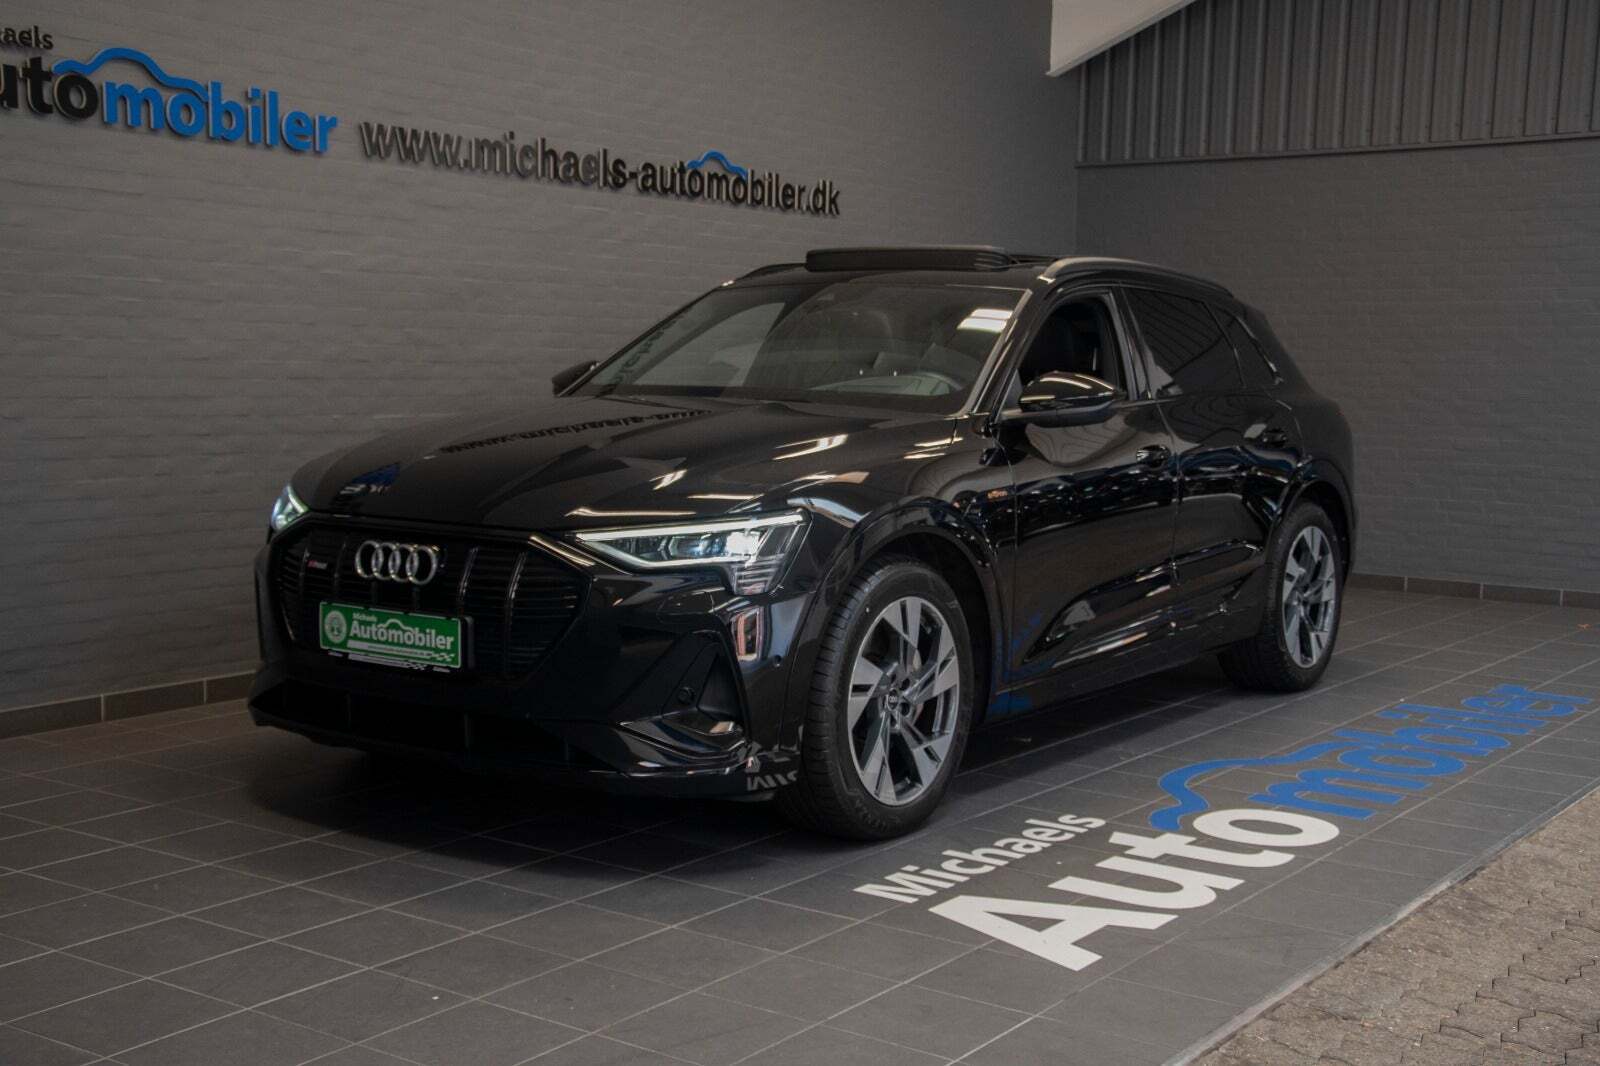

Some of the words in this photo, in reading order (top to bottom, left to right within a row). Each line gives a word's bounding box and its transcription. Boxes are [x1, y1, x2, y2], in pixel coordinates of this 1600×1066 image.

[0, 26, 54, 50] aels
[359, 121, 840, 215] www.michaels-automobiler.dk
[350, 621, 454, 650] Automobiler
[853, 814, 1106, 904] Michaels
[928, 684, 1593, 971] Automobiler
